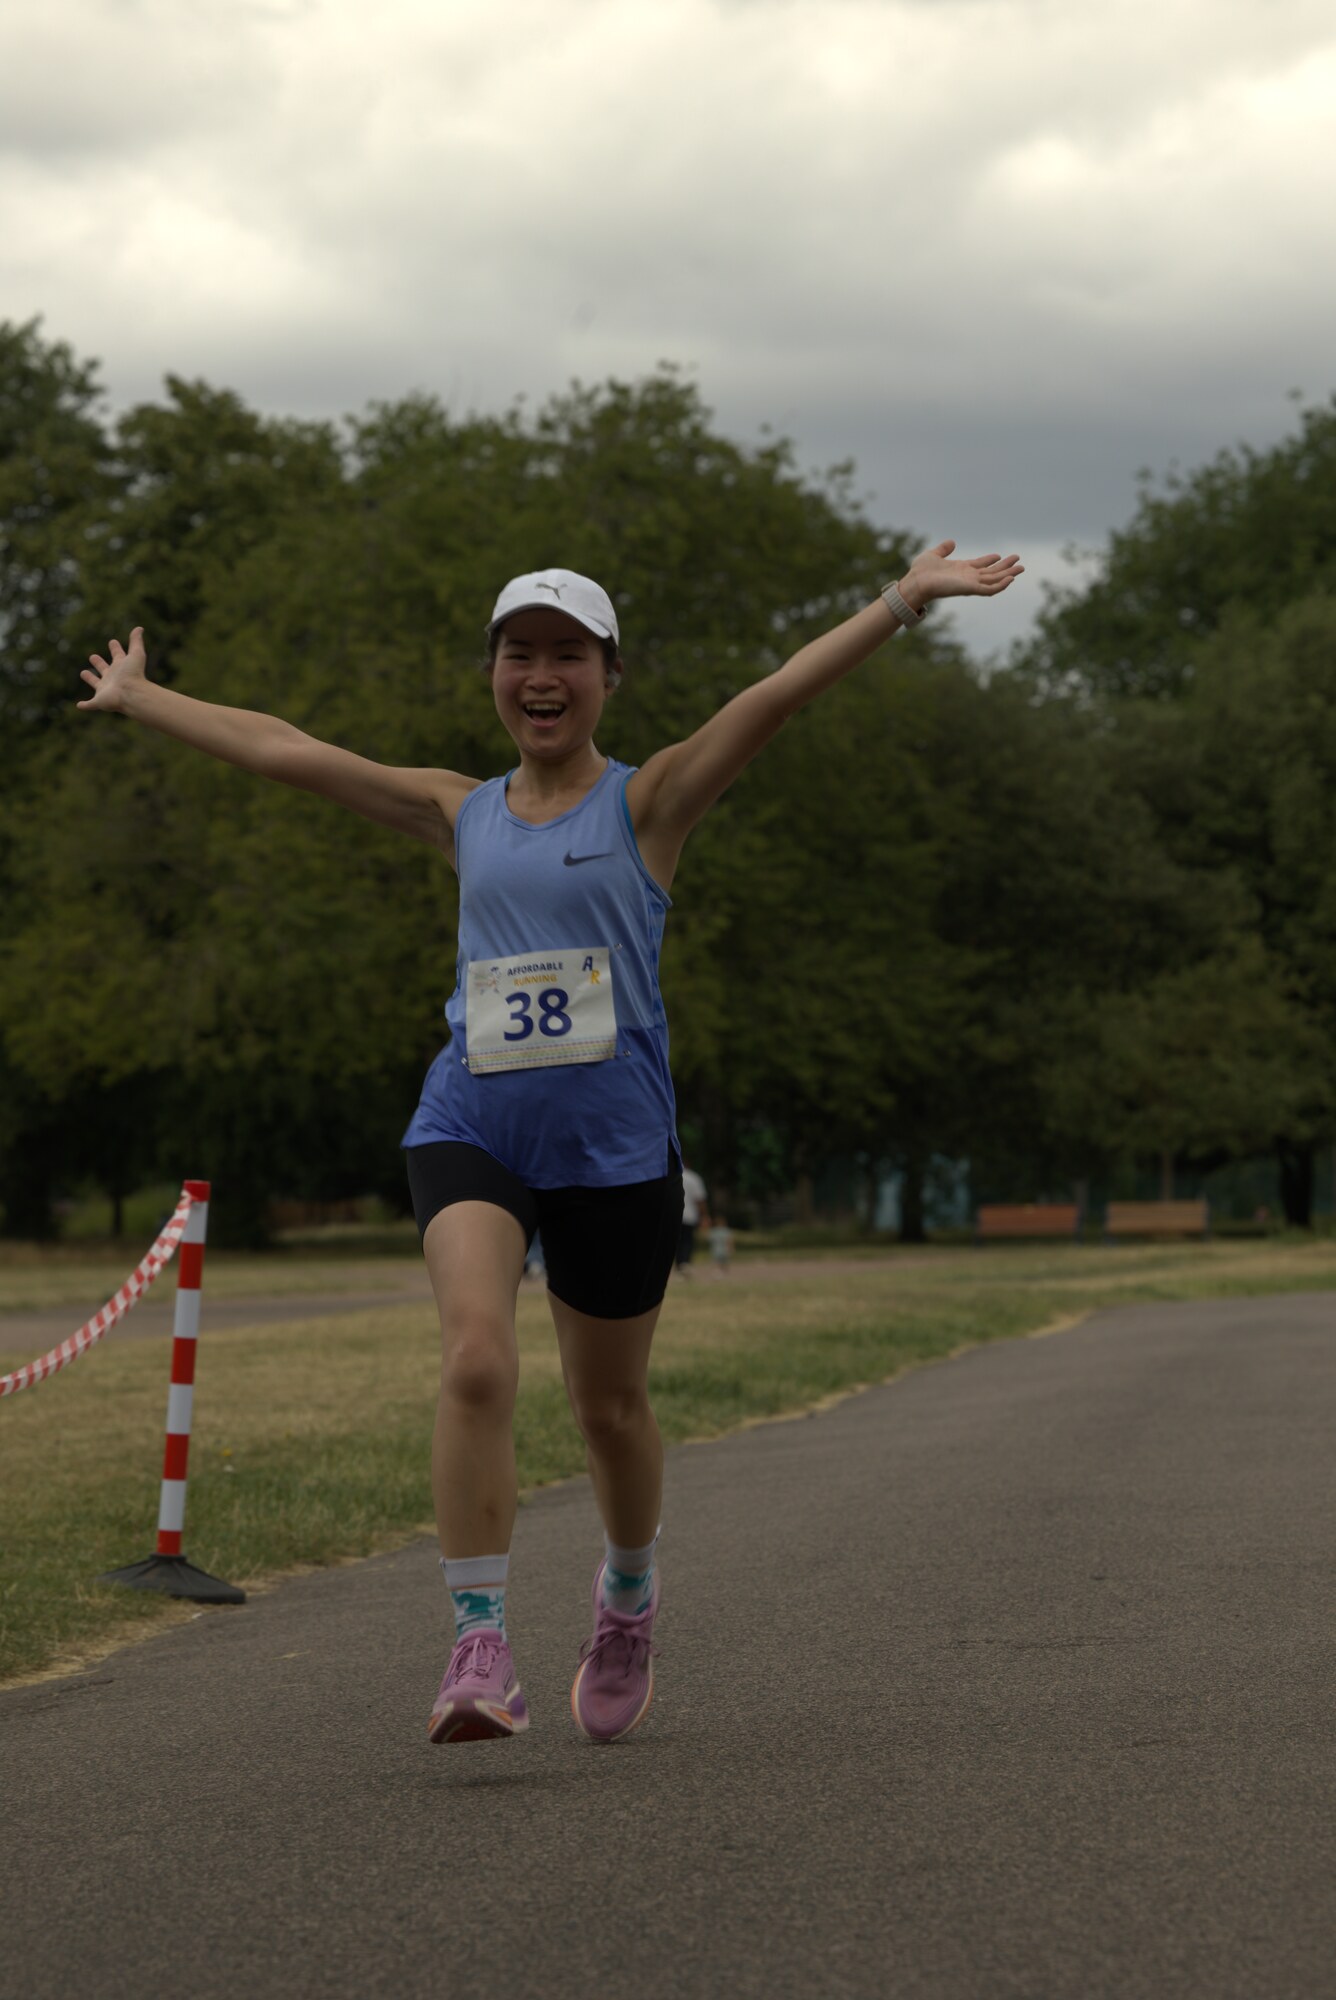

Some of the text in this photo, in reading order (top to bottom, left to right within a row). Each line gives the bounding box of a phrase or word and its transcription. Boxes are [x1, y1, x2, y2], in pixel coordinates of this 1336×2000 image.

[507, 961, 563, 976] AFFORDABLE
[582, 956, 593, 971] A
[513, 974, 558, 986] RUNNING
[504, 988, 572, 1041] 38
